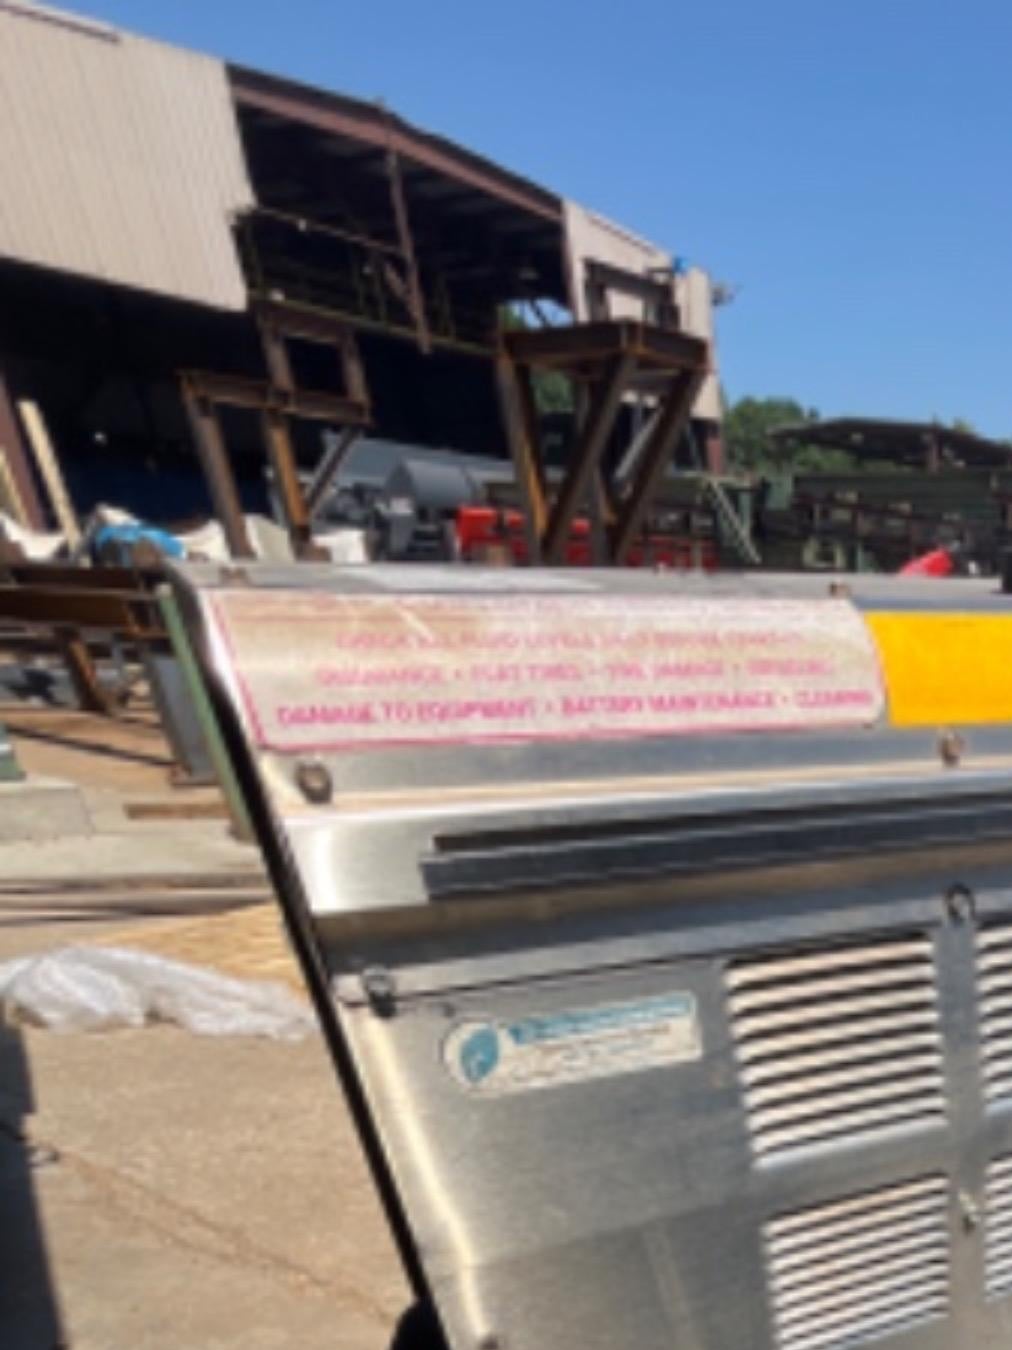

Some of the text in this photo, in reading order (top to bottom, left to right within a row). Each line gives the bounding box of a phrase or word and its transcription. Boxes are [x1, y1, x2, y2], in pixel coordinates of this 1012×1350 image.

[277, 702, 374, 727] DAMAGE
[380, 701, 412, 723] TO
[417, 697, 532, 723] EQUIPMENT
[561, 693, 643, 717] BATTERY
[649, 689, 774, 712] MAINTENANCE
